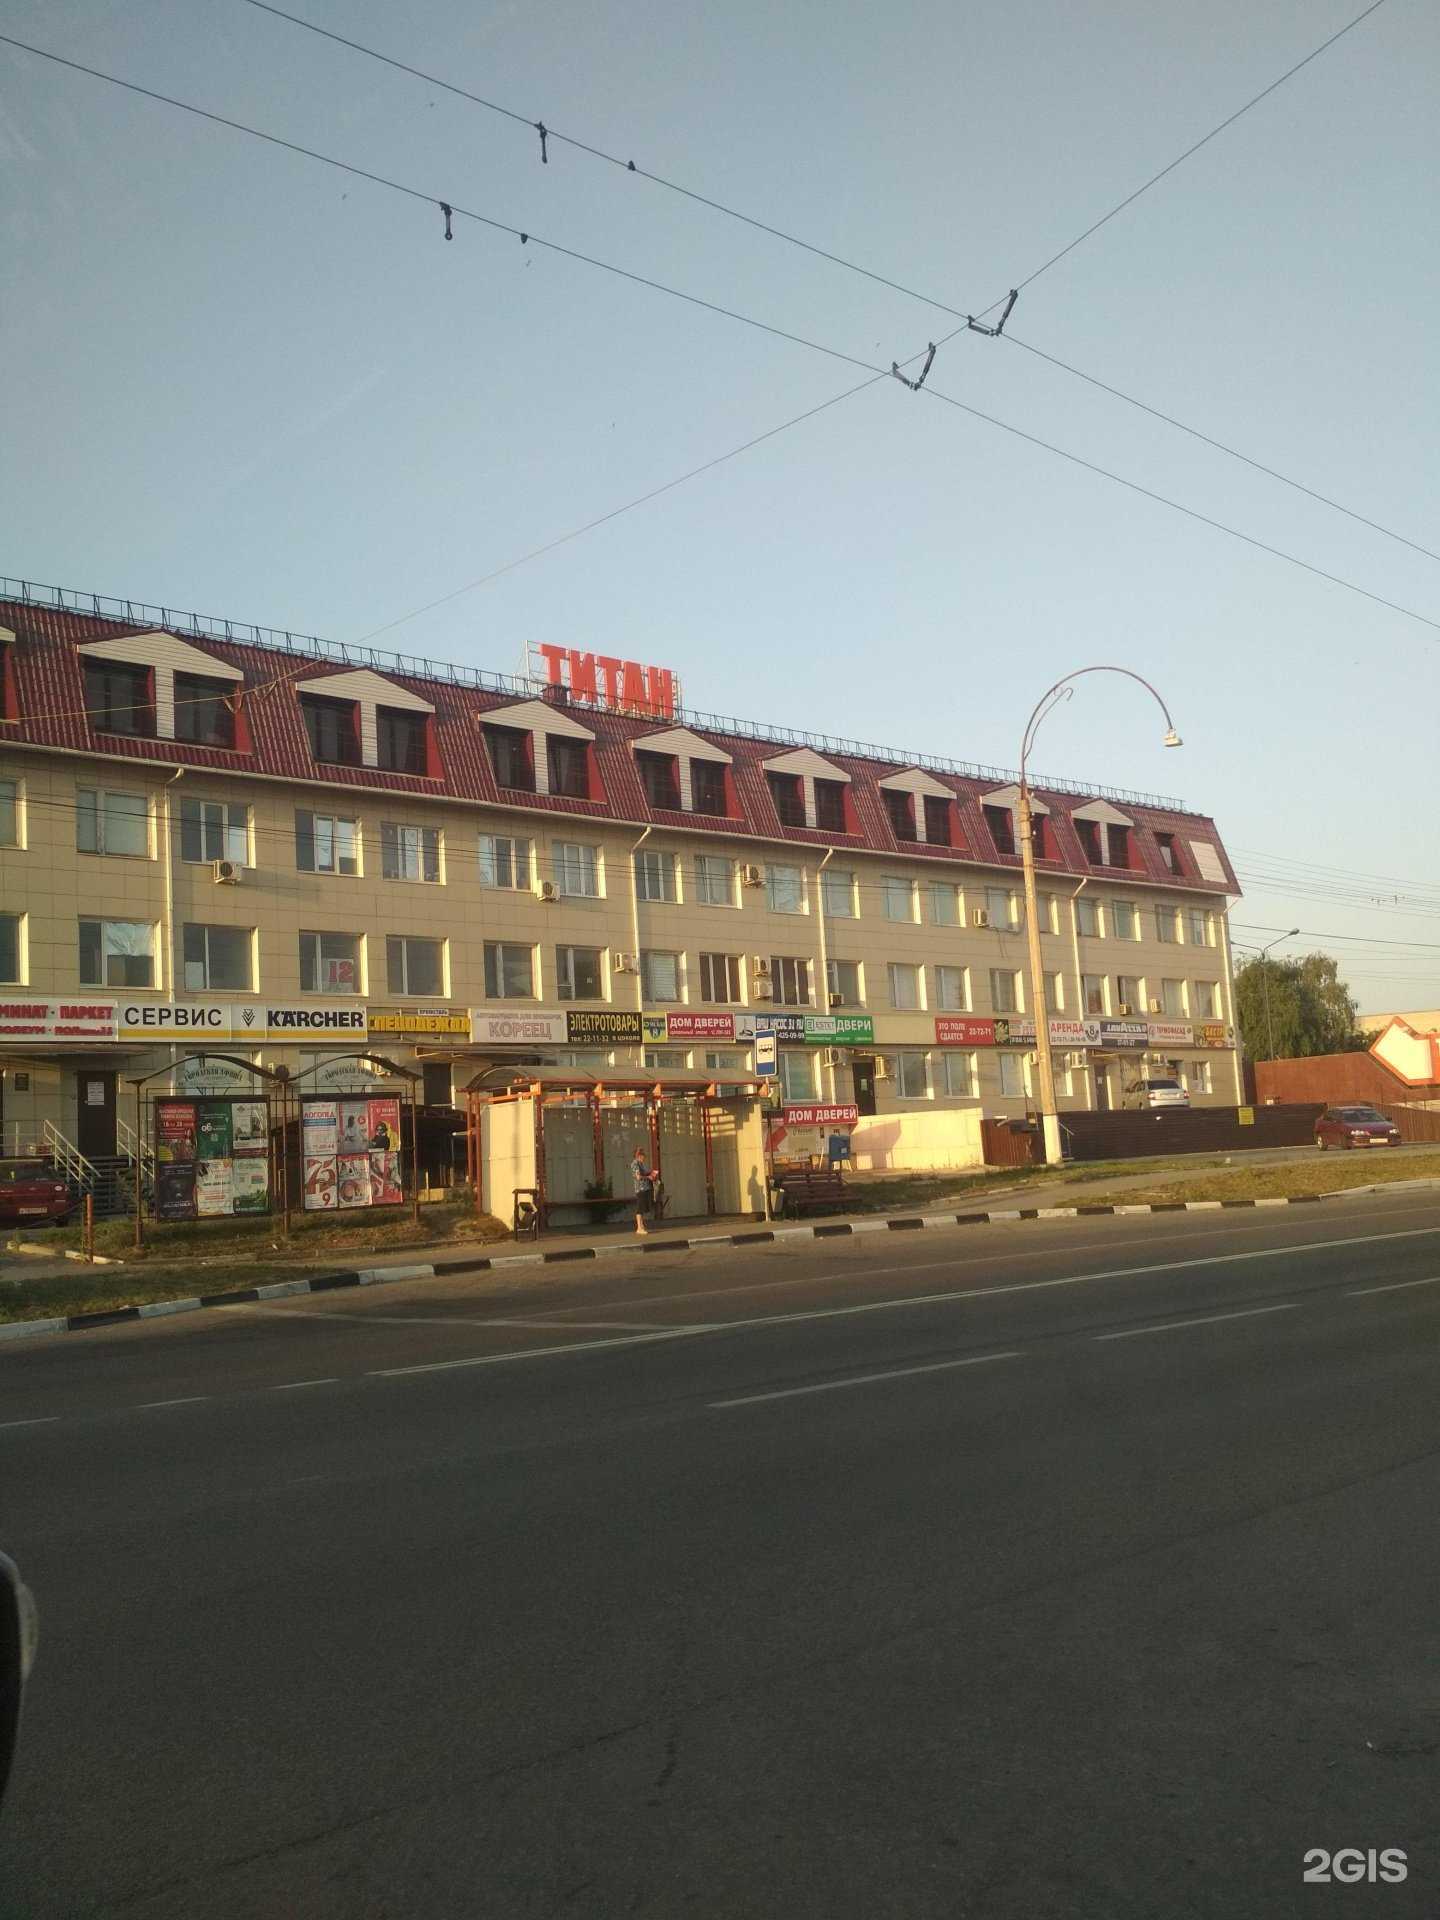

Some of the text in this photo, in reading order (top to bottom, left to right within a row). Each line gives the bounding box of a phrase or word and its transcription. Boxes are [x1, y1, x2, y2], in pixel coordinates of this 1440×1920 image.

[540, 643, 674, 719] ТИТАН
[60, 1005, 113, 1019] ПАРКЕТ
[124, 1007, 222, 1026] СЕРВИС
[267, 1010, 364, 1027] KÄRCHER
[488, 1021, 552, 1040] КОРЕЕЦ
[570, 1014, 640, 1032] ЭЛЕКТРОТОВАРЫ
[670, 1017, 692, 1028] ДОМ
[694, 1016, 732, 1029] ДВЕРЕЙ
[837, 1019, 872, 1032] ДВЕРИ
[1051, 1023, 1084, 1035] АРЕНДА
[788, 1107, 857, 1123] ДОМ ДВЕРЕЙ
